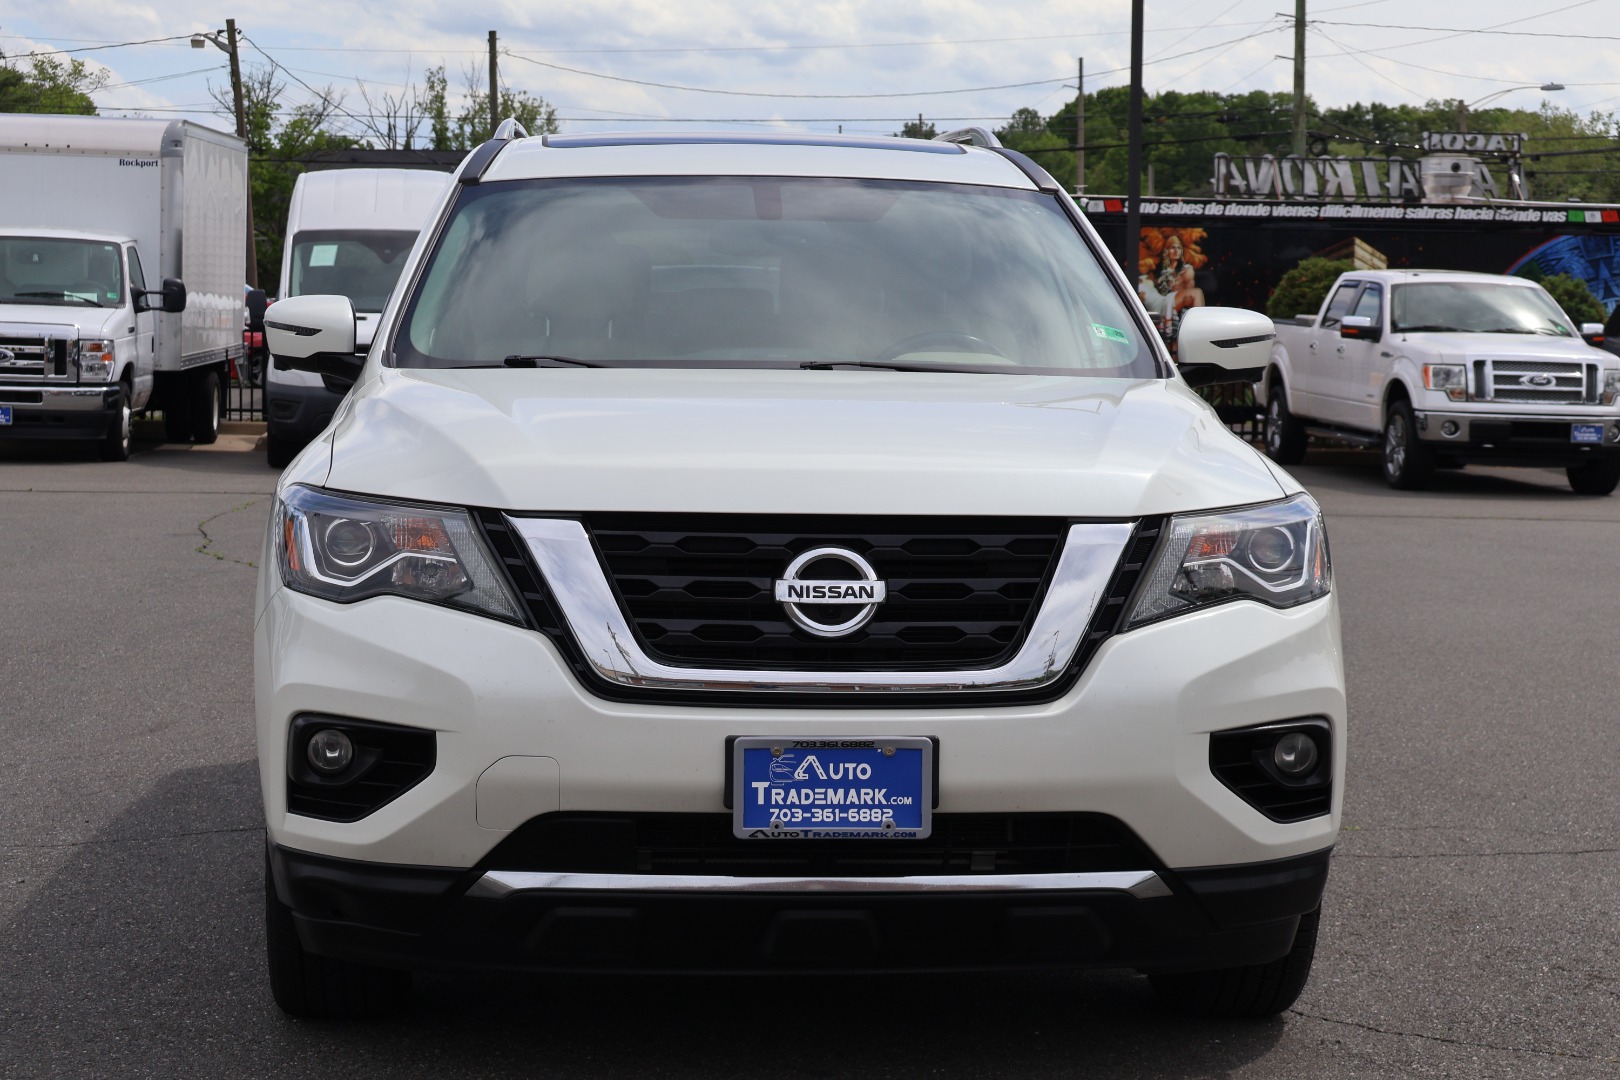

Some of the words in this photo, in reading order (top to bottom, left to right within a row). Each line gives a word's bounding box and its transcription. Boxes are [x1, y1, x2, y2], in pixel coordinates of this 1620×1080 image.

[119, 159, 158, 168] Rockport
[1139, 203, 1158, 213] no
[1159, 202, 1205, 215] sabes
[1205, 202, 1223, 215] de
[1224, 202, 1271, 216] donde
[1271, 203, 1319, 217] vienes
[1405, 206, 1454, 220] sabras
[1454, 207, 1495, 220] hacia
[1495, 208, 1541, 222] donde
[1541, 210, 1567, 222] vas
[787, 584, 875, 599] NISSAN
[792, 740, 875, 748] 703.361.6882
[769, 808, 894, 822] 703-361-6882
